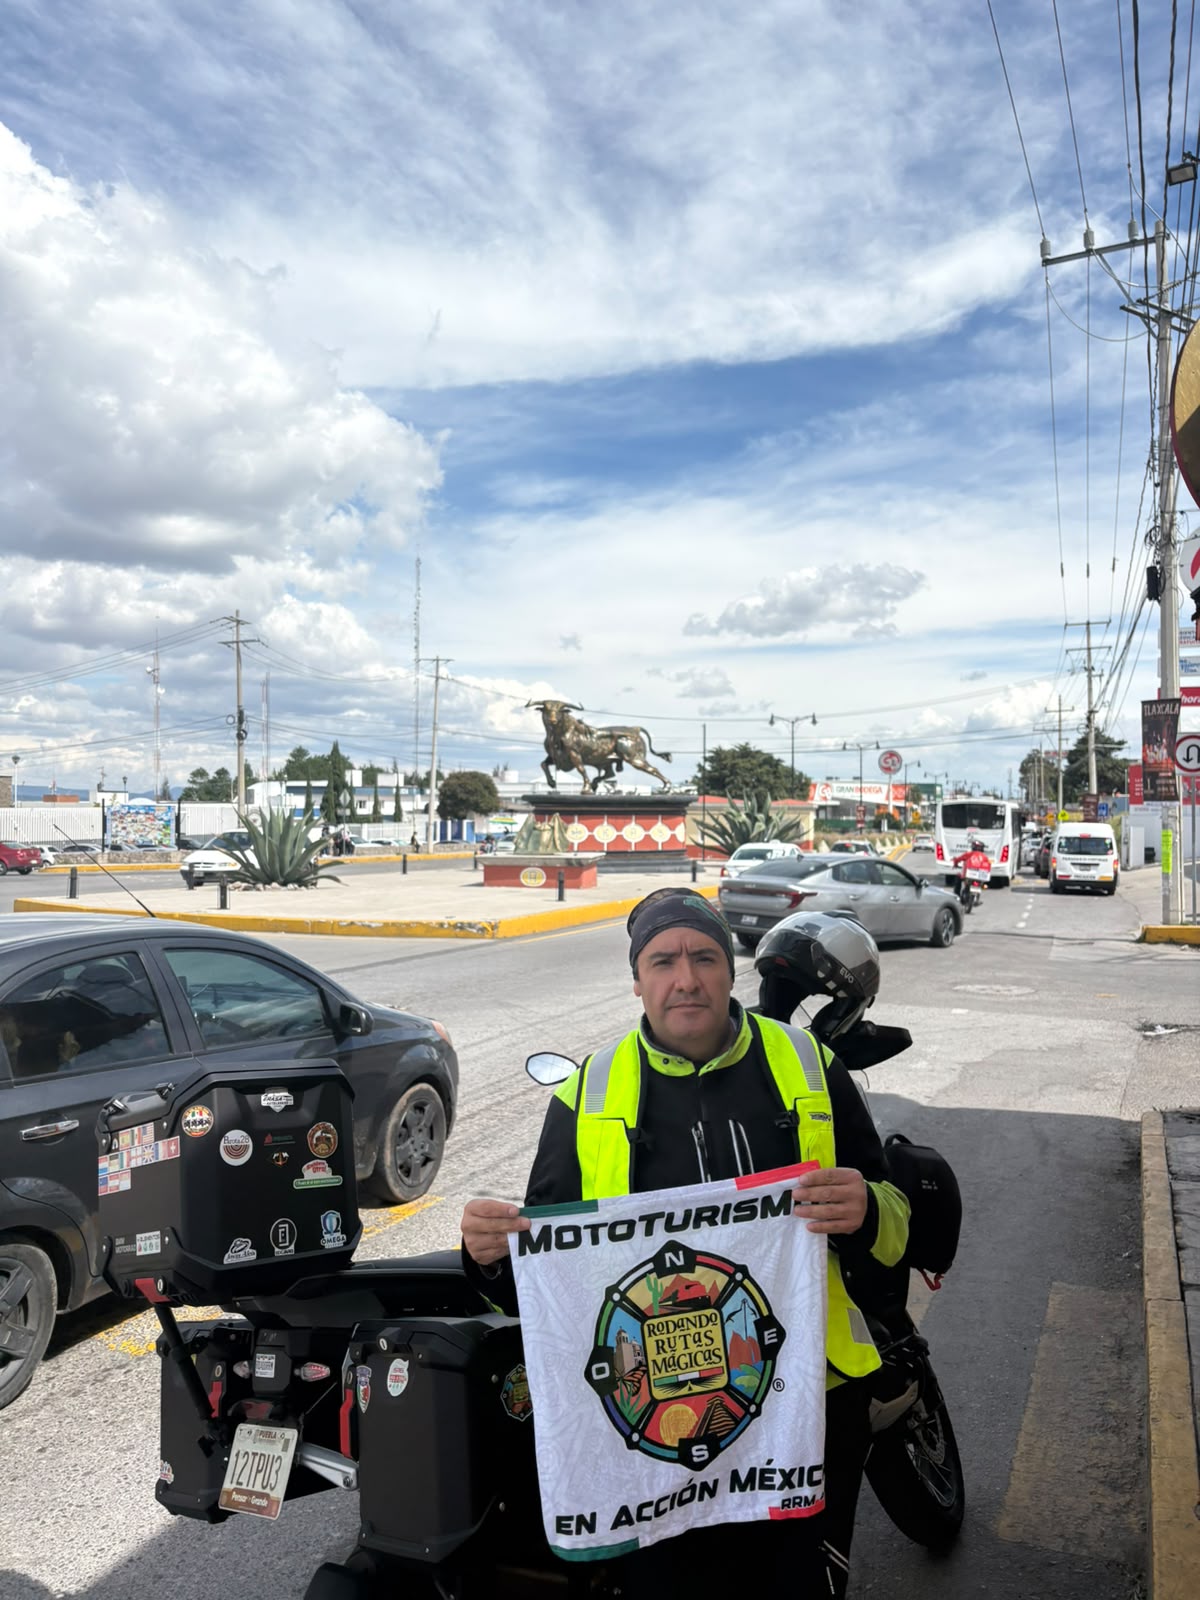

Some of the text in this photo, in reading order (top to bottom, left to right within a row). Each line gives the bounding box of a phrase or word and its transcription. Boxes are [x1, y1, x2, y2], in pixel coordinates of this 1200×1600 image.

[1143, 702, 1179, 717] TLAXCALA
[836, 785, 883, 793] GRAN BODEGA
[839, 966, 854, 984] EVO
[517, 1189, 822, 1257] MOTOTURISM
[321, 1235, 346, 1245] OMEGA
[664, 1250, 685, 1268] N
[763, 1328, 779, 1345] E
[259, 1429, 278, 1440] PUEBLA
[691, 1444, 710, 1462] S
[230, 1449, 283, 1492] 12TPU3
[555, 1458, 825, 1536] EN ACCIÓN MÉXIC
[781, 1494, 816, 1510] RRM
